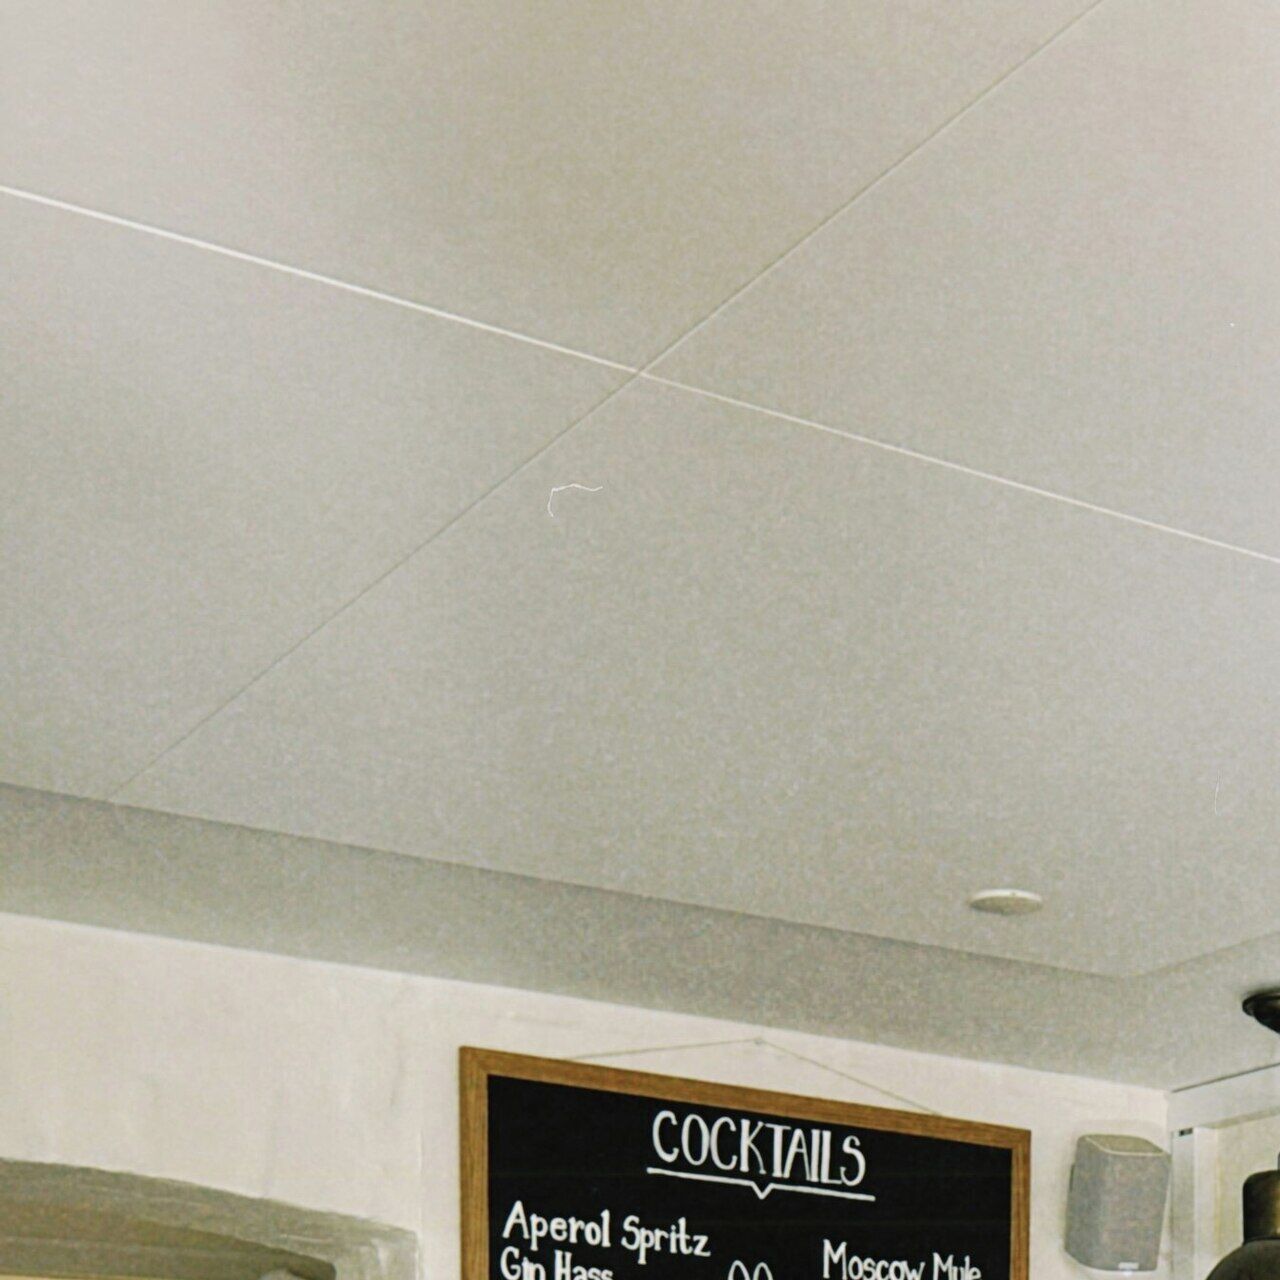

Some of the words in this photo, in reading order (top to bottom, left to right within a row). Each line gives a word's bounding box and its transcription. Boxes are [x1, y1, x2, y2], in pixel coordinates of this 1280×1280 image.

[652, 1110, 867, 1186] COCKTAILS
[502, 1200, 611, 1251] Aperol
[621, 1215, 711, 1265] Spritz
